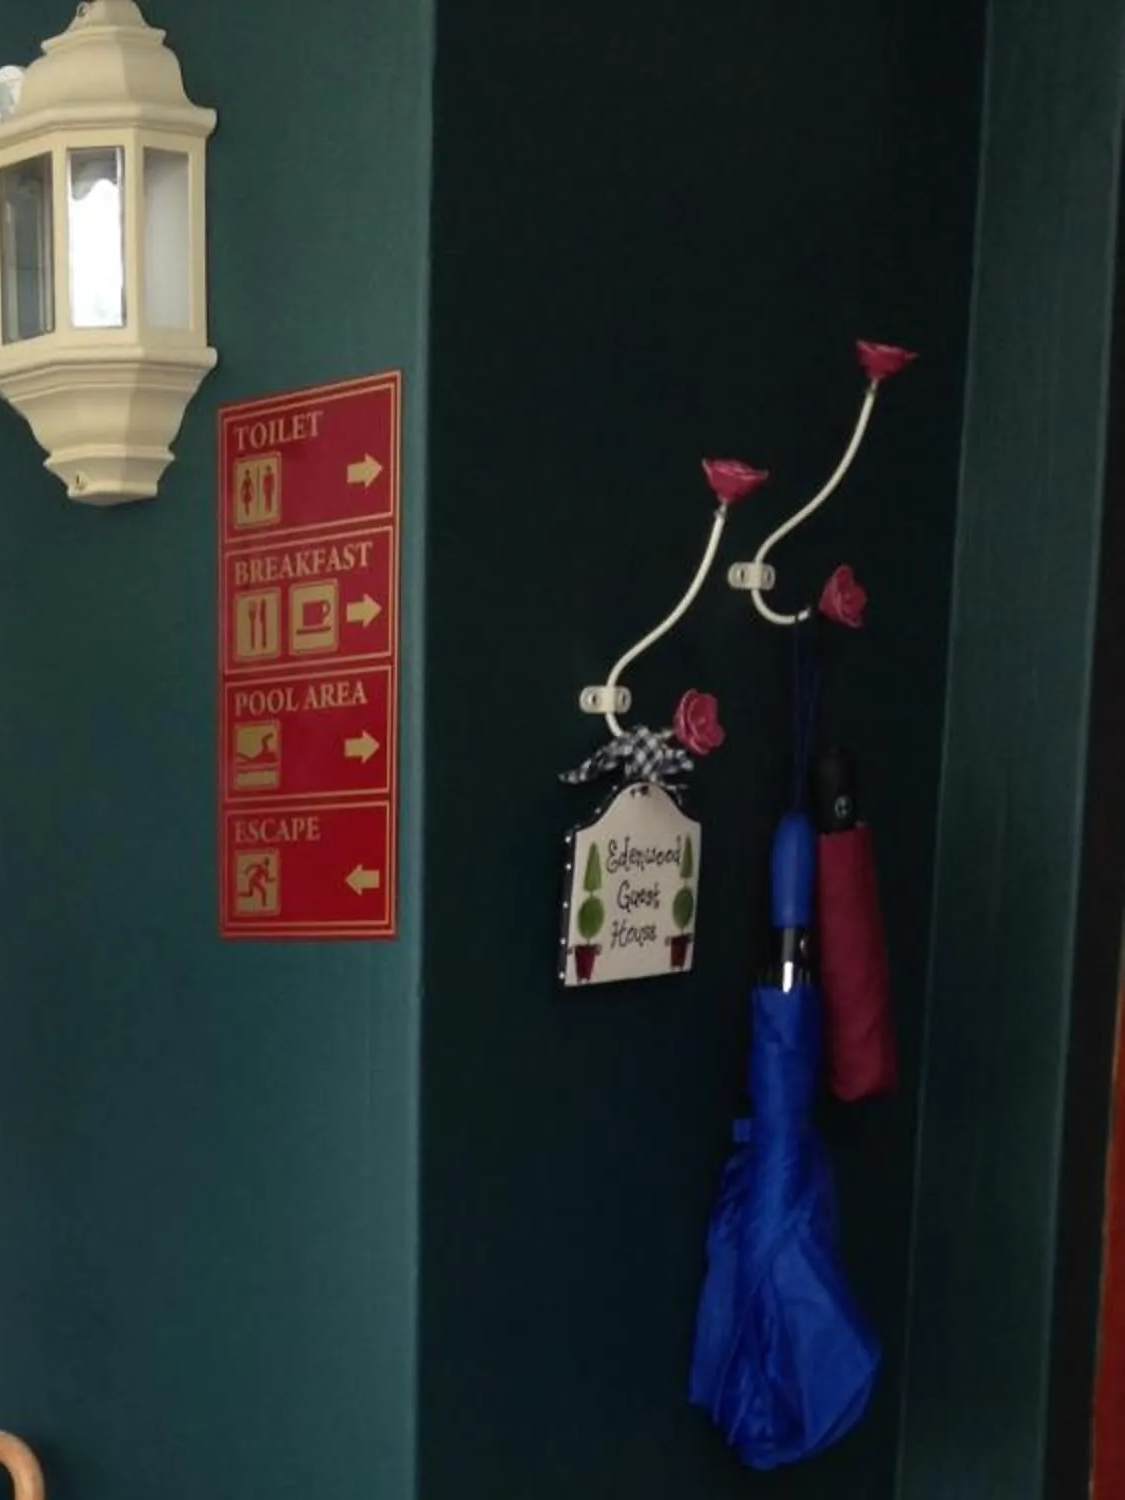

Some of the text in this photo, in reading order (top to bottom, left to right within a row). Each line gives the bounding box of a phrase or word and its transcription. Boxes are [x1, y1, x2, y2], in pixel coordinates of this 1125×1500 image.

[233, 410, 324, 451] TOILET
[235, 541, 374, 586] BREAKFAST
[235, 680, 368, 718] POOL AREA
[234, 816, 322, 844] ESCAPE
[617, 879, 661, 913] Guest
[610, 919, 658, 949] House
